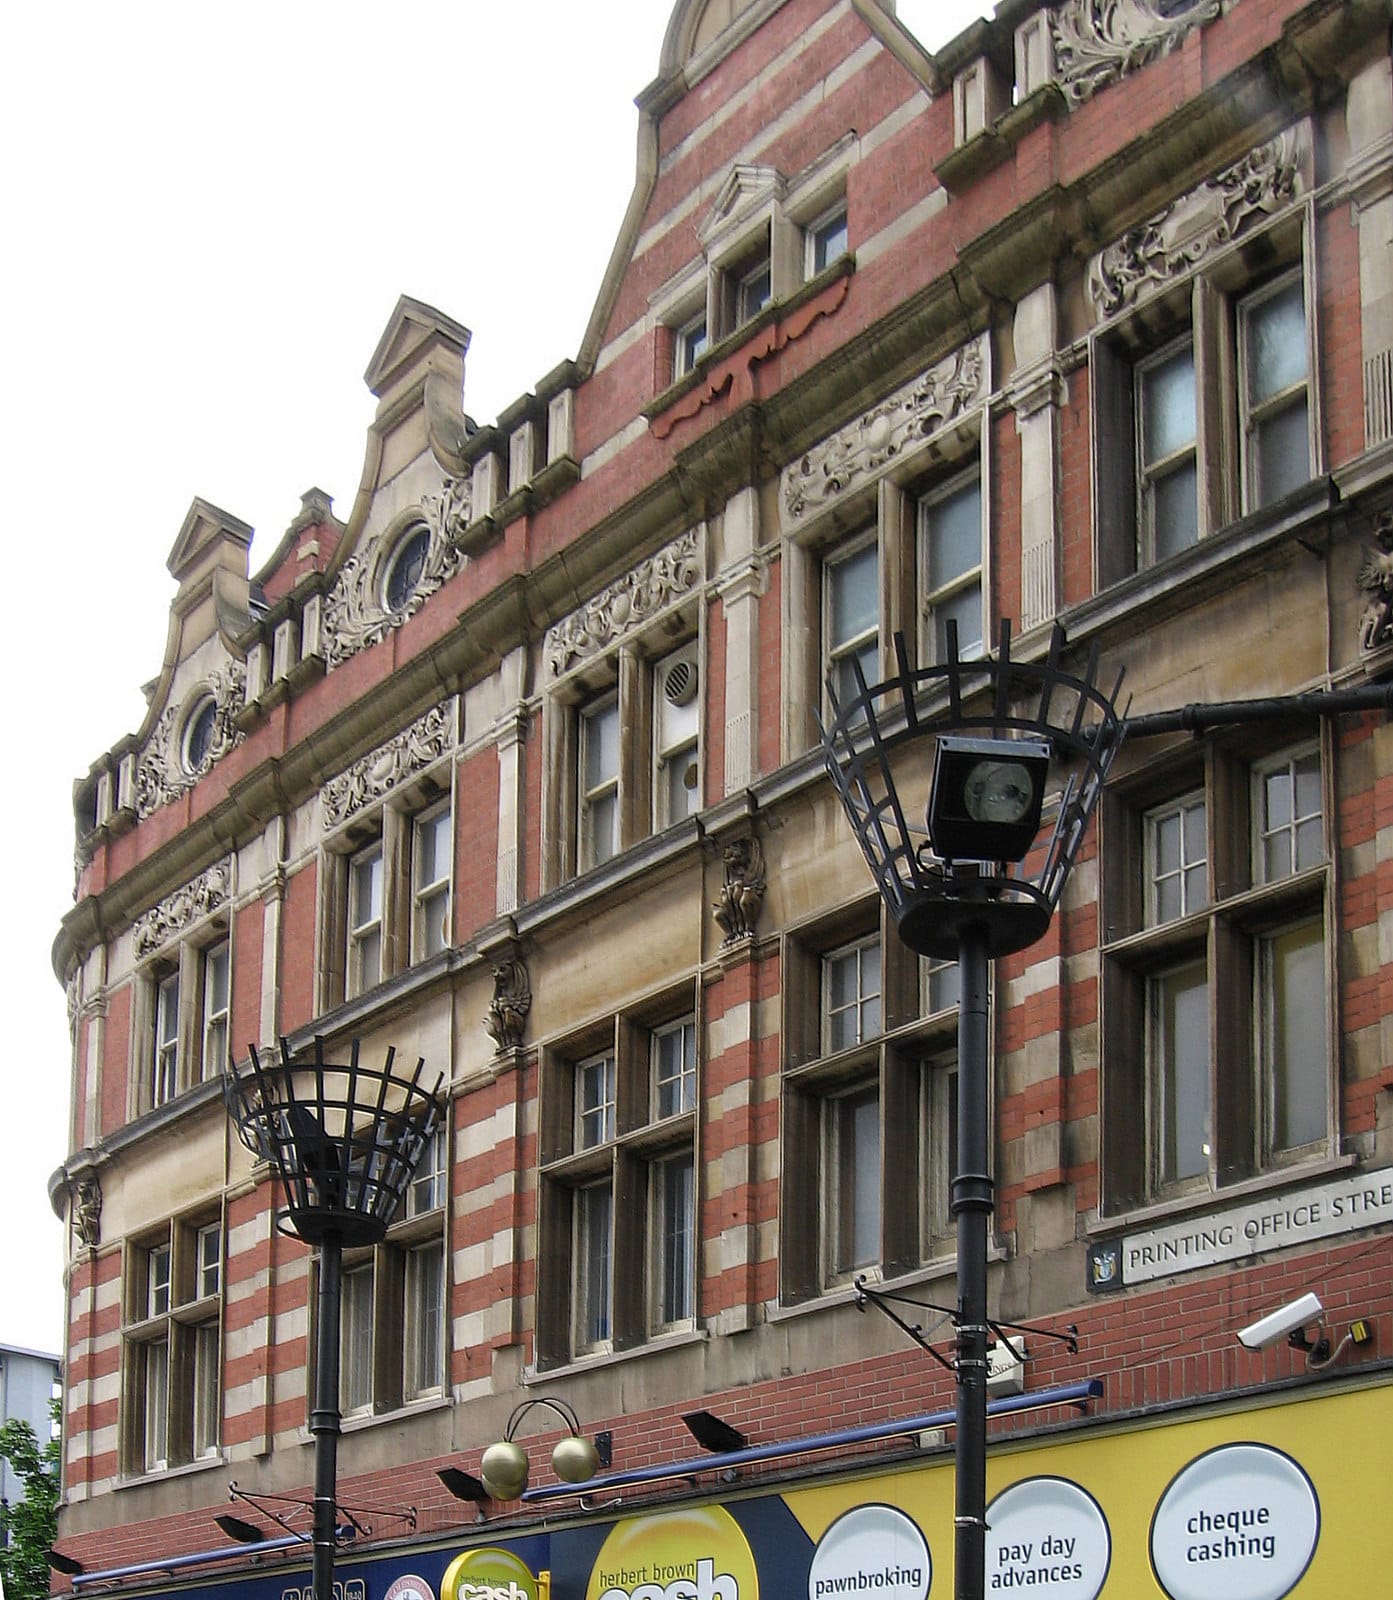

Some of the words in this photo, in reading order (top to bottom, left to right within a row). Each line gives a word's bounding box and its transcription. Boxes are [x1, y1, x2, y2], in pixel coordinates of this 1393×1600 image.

[1130, 1226, 1233, 1268] PRINTING
[1244, 1203, 1320, 1239] OFFICE
[1331, 1184, 1393, 1217] STRE
[1187, 1507, 1269, 1534] cheque
[998, 1543, 1033, 1567] pay
[1041, 1535, 1076, 1559] day
[1187, 1533, 1275, 1562] cashing
[600, 1566, 648, 1588] herbert
[653, 1562, 695, 1581] brown
[815, 1565, 922, 1600] pawnbroking
[991, 1563, 1082, 1589] advances
